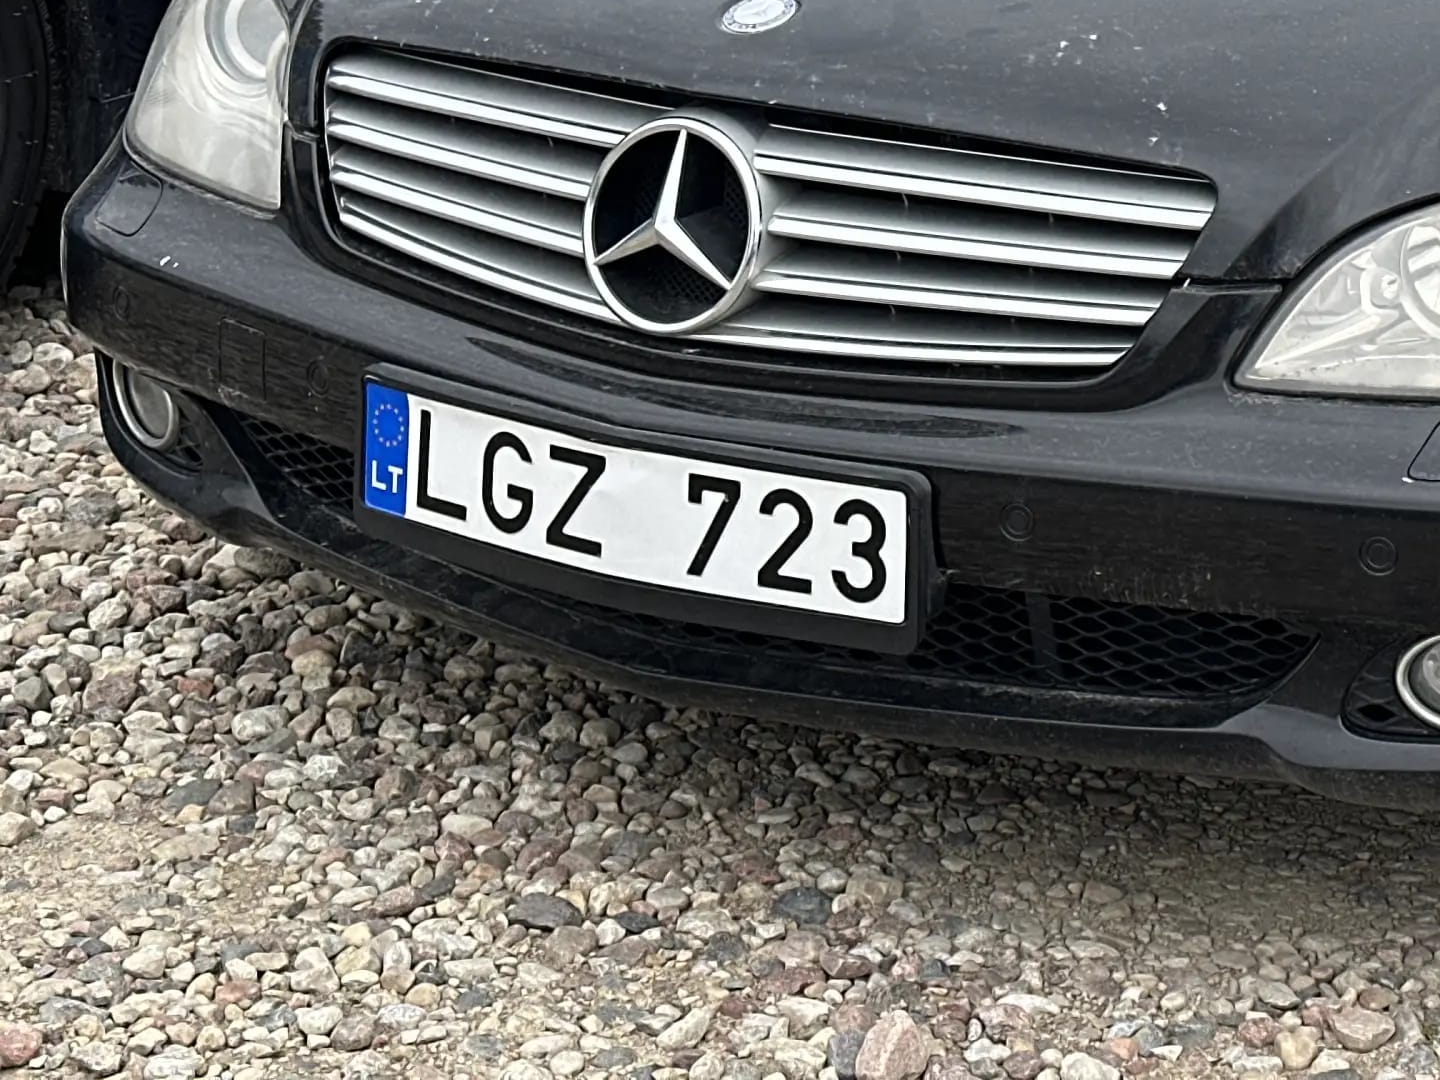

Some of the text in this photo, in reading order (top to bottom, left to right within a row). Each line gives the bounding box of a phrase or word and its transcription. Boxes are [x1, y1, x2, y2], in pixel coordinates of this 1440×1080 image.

[371, 459, 404, 494] LT
[416, 409, 887, 604] LGZ 723
